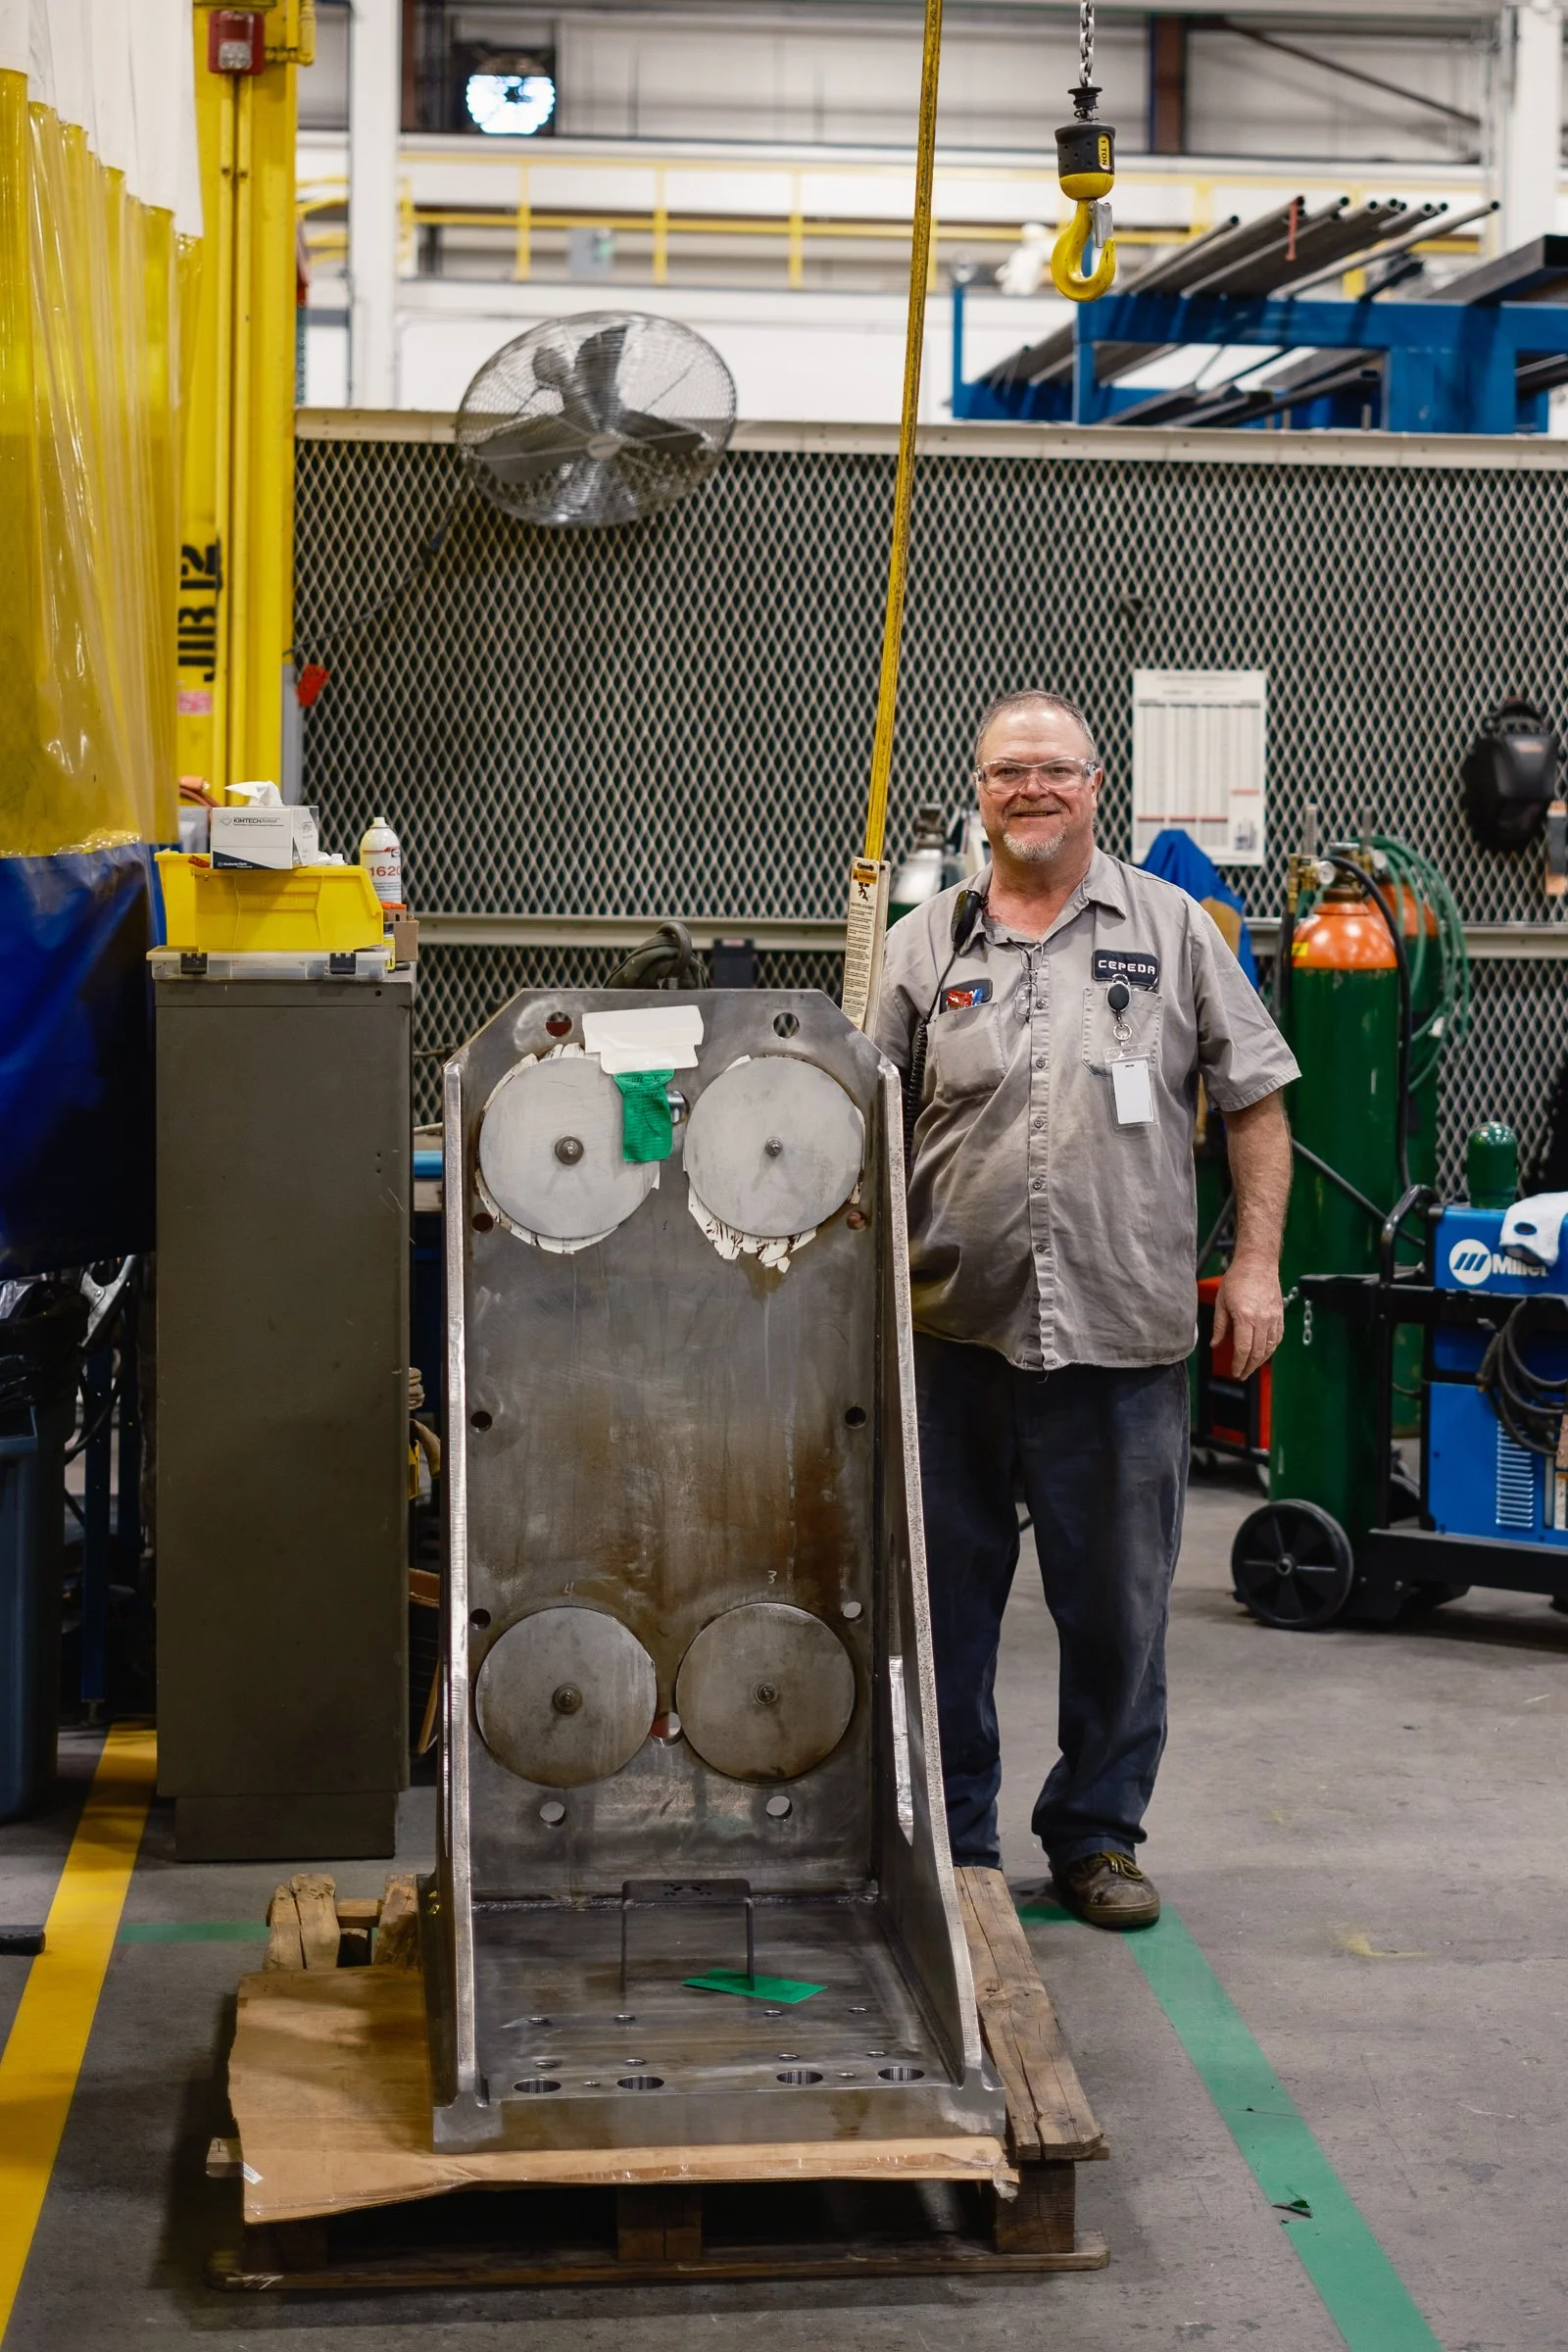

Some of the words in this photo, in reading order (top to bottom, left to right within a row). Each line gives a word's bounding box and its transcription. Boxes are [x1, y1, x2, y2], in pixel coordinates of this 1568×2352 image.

[180, 543, 221, 591] 12
[177, 607, 217, 682] JIB
[1098, 959, 1155, 975] CEPEDA
[767, 1570, 777, 1585] 3
